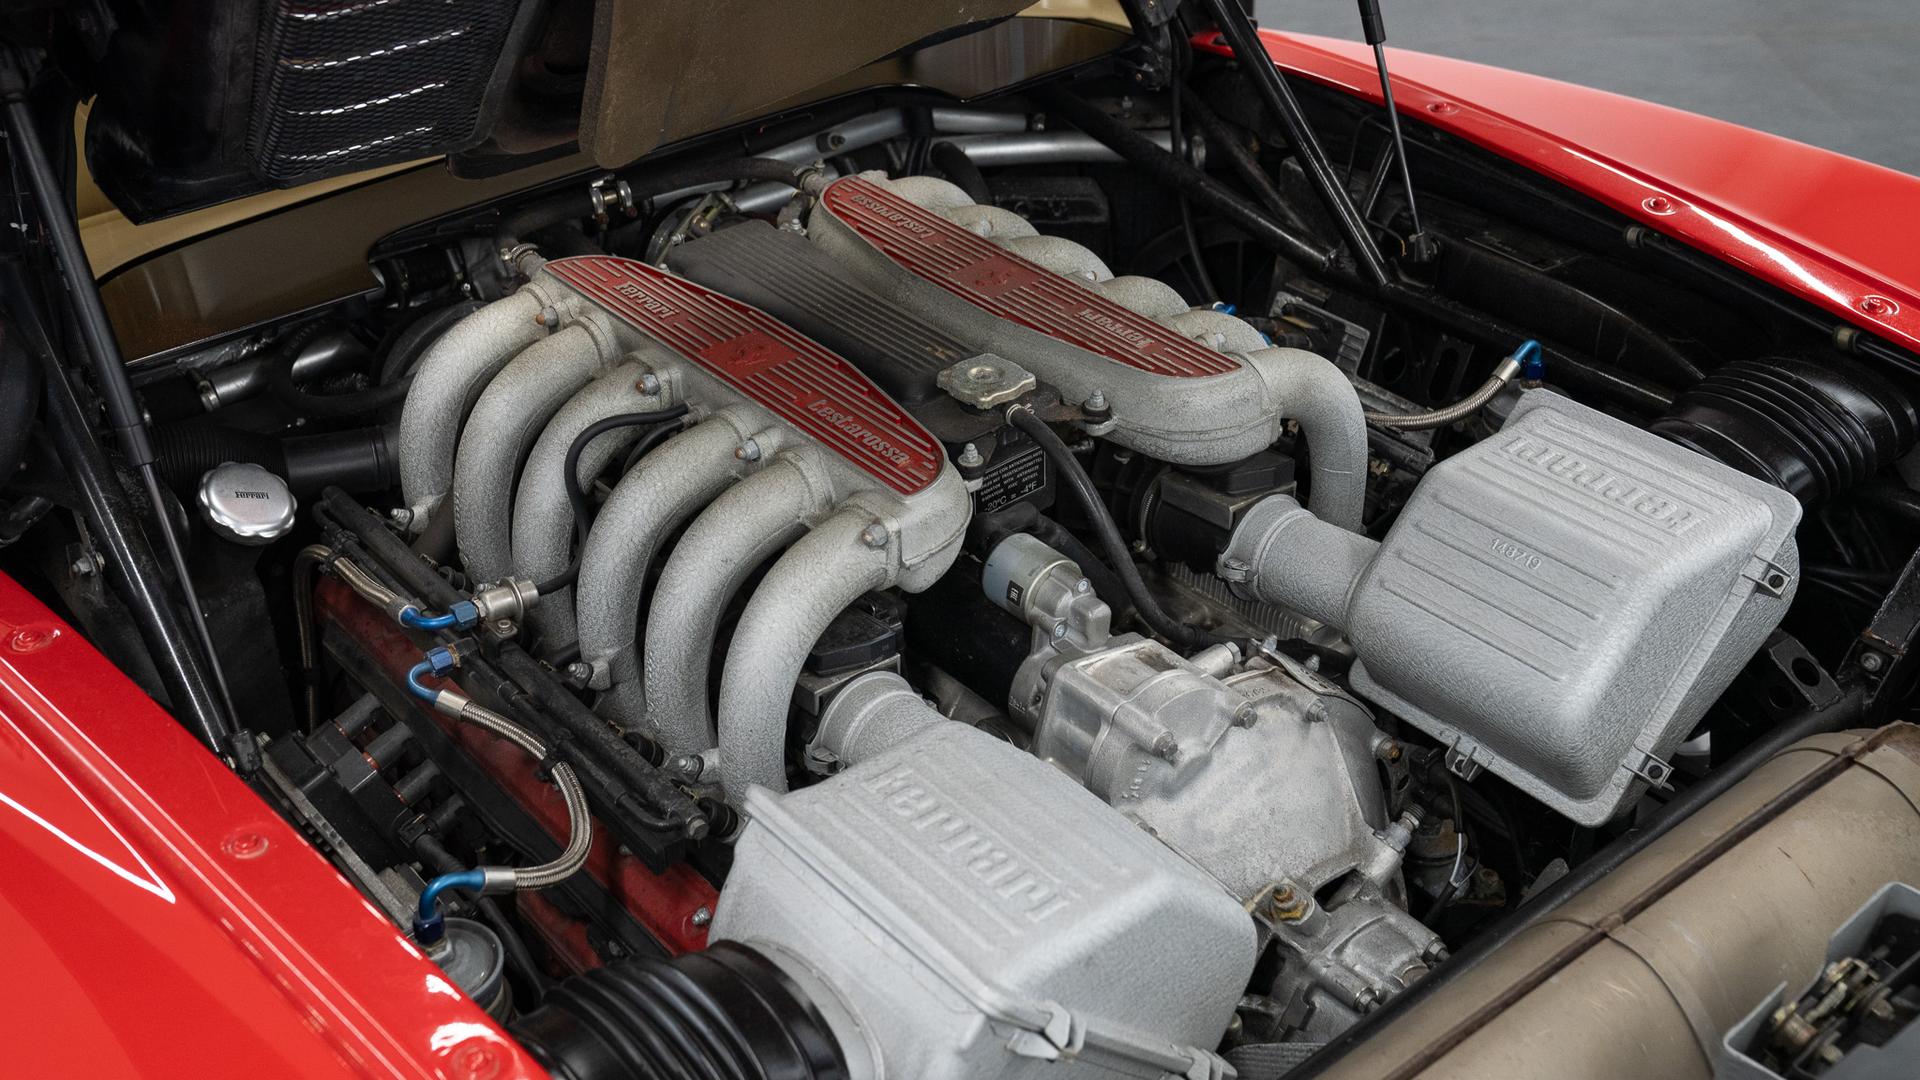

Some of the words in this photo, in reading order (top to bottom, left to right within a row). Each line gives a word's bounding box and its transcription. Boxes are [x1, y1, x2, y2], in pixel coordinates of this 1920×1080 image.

[612, 281, 681, 319] Ferrari
[1074, 308, 1155, 350] Ferrari
[234, 491, 270, 499] Ferrari
[1499, 436, 1706, 537] Ferrari
[1491, 538, 1541, 570] 148719
[860, 763, 1082, 923] Ferrari
